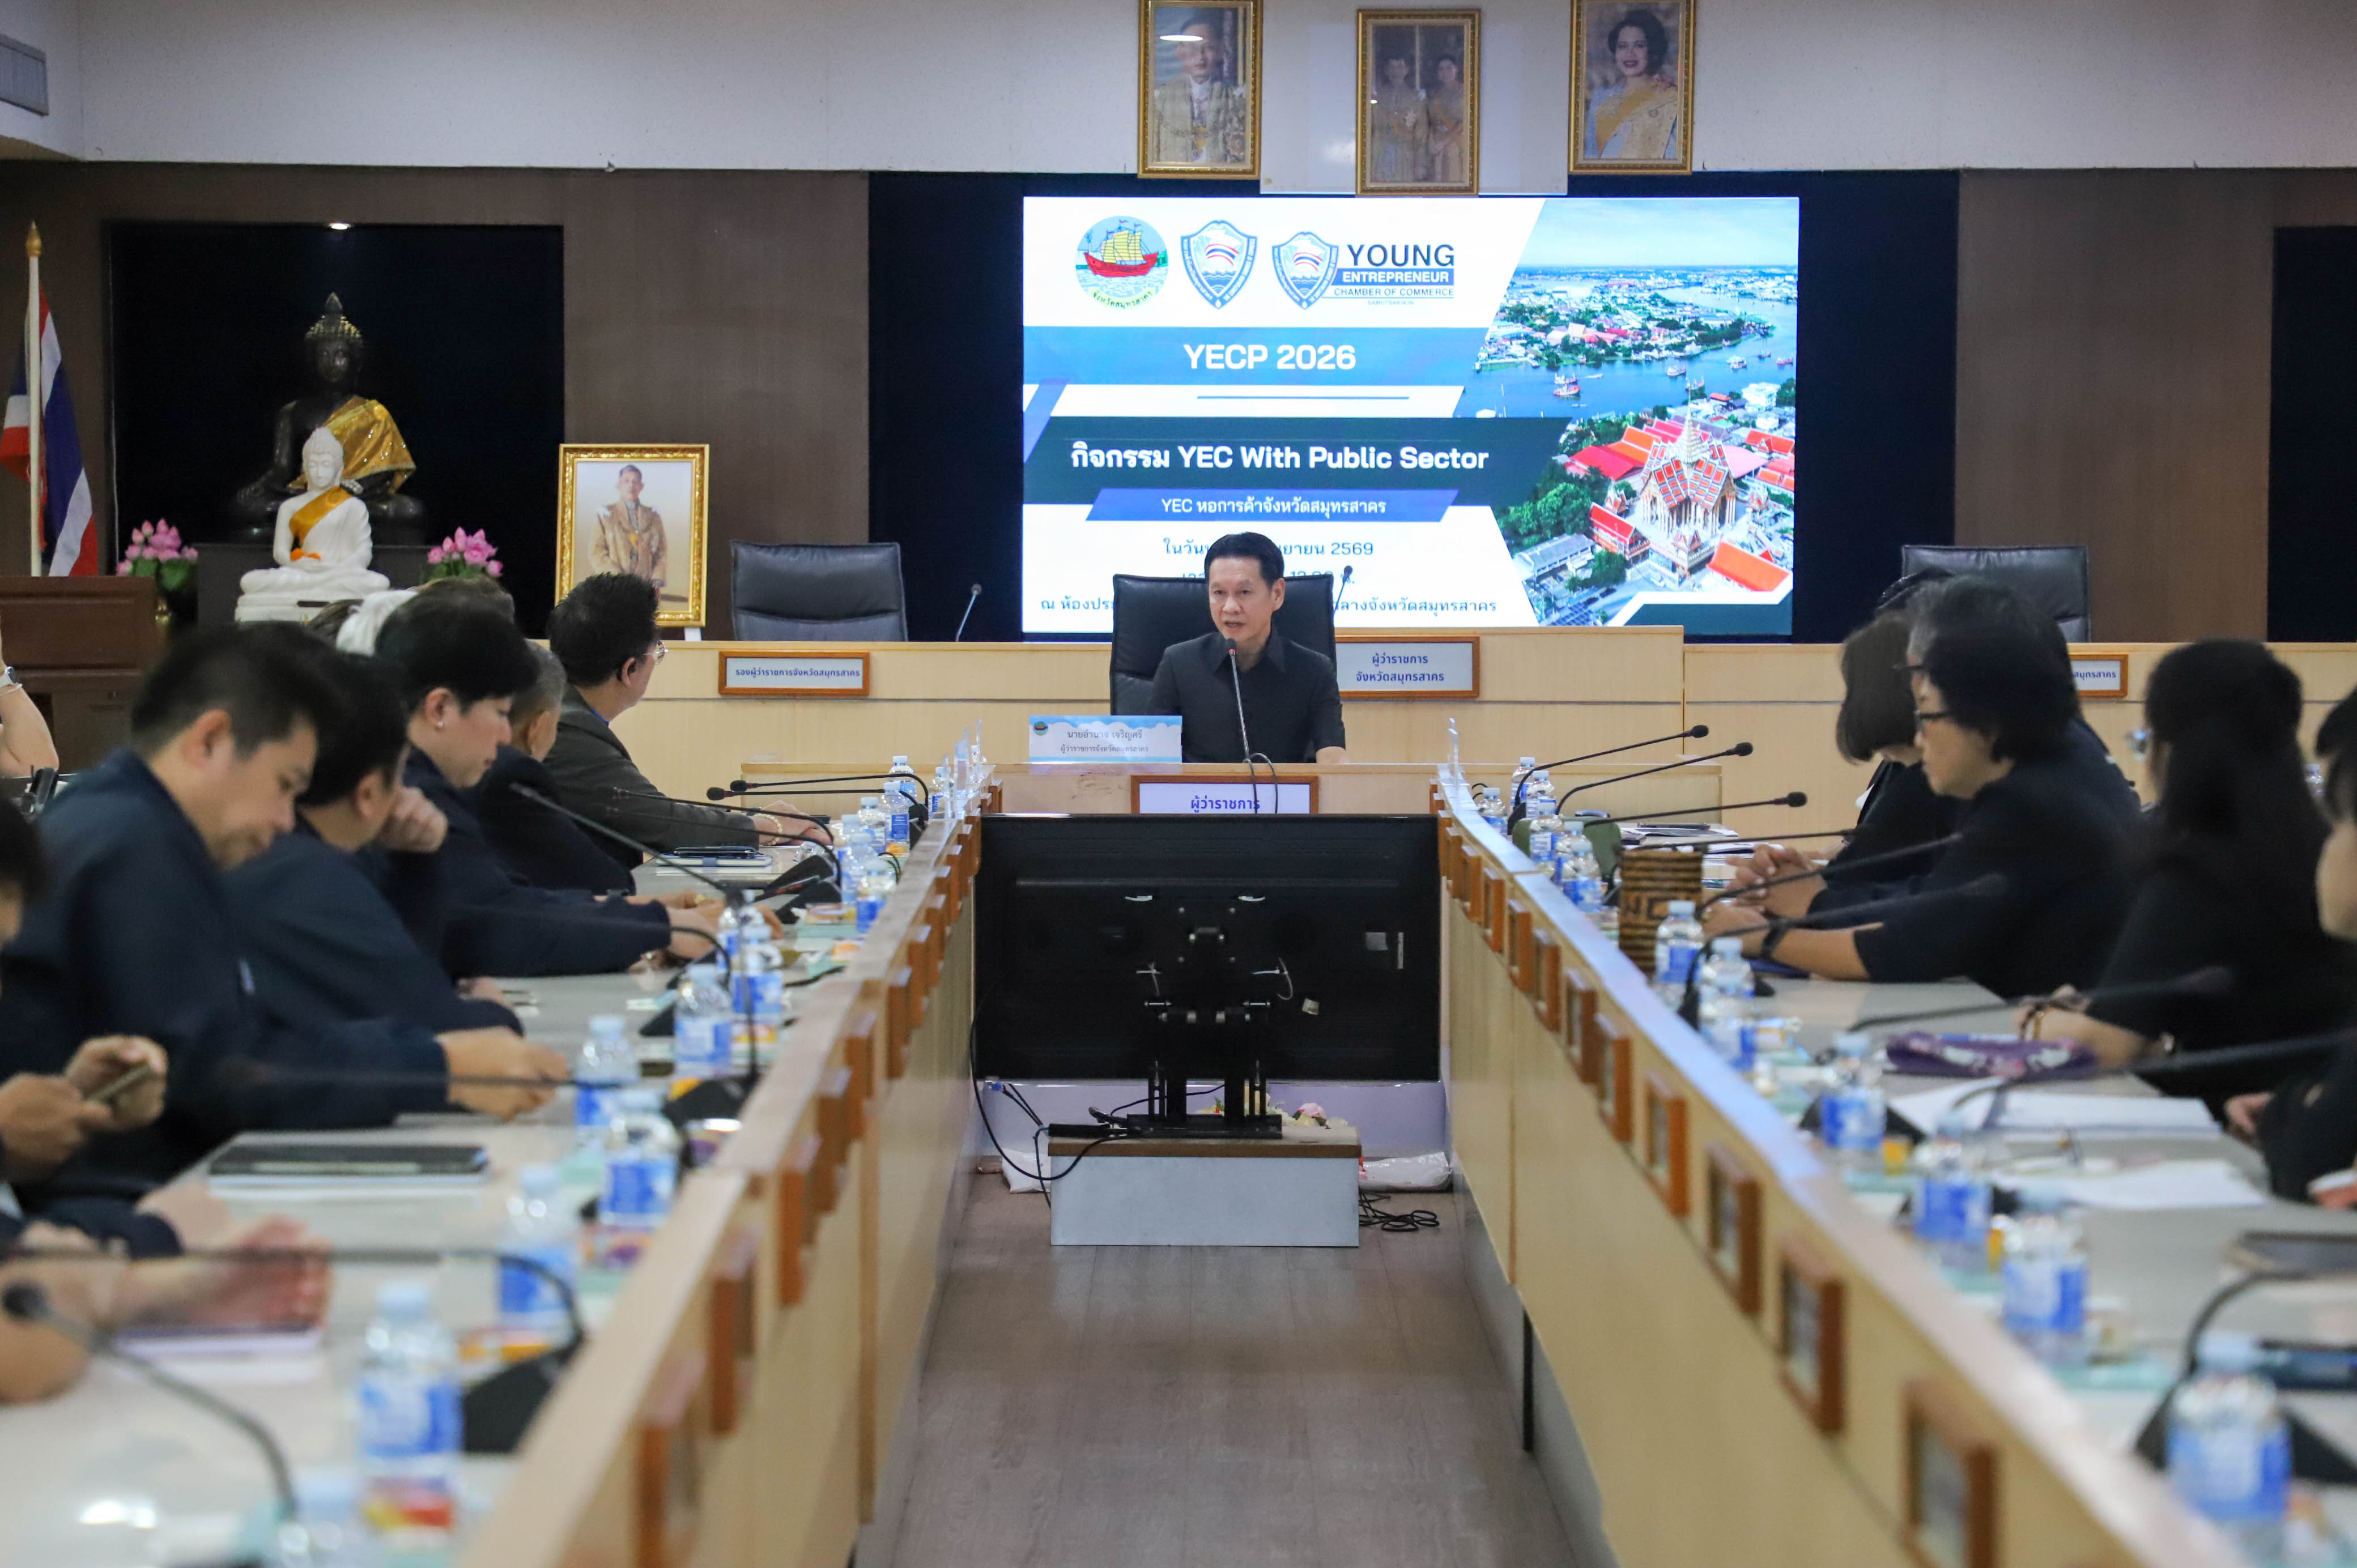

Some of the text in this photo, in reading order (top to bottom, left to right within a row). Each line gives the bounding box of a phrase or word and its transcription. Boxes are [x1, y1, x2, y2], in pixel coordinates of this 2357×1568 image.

[1347, 244, 1454, 267] YOUNG
[1342, 271, 1449, 283] ENTREPRENEUR
[1334, 288, 1454, 296] CHAMBER OF COMMERCE
[1183, 344, 1356, 370] YECP 2026
[1071, 440, 1490, 469] กิจกรรม YEC With Public Sector
[1162, 496, 1387, 519] YEC หอการค้าจังหวัดสมุทรสาคร
[1331, 543, 1374, 555] 2569
[1041, 599, 1054, 610] ณ
[1372, 652, 1428, 667] ผู้ว่าราชการ
[735, 667, 860, 679] รองผู้ว่าราชการจังหวัดสมุทรสาคร
[1356, 671, 1445, 684] จังหวัดสมุทรสาคร
[1190, 795, 1261, 813] ผู้ว่าราชการ
